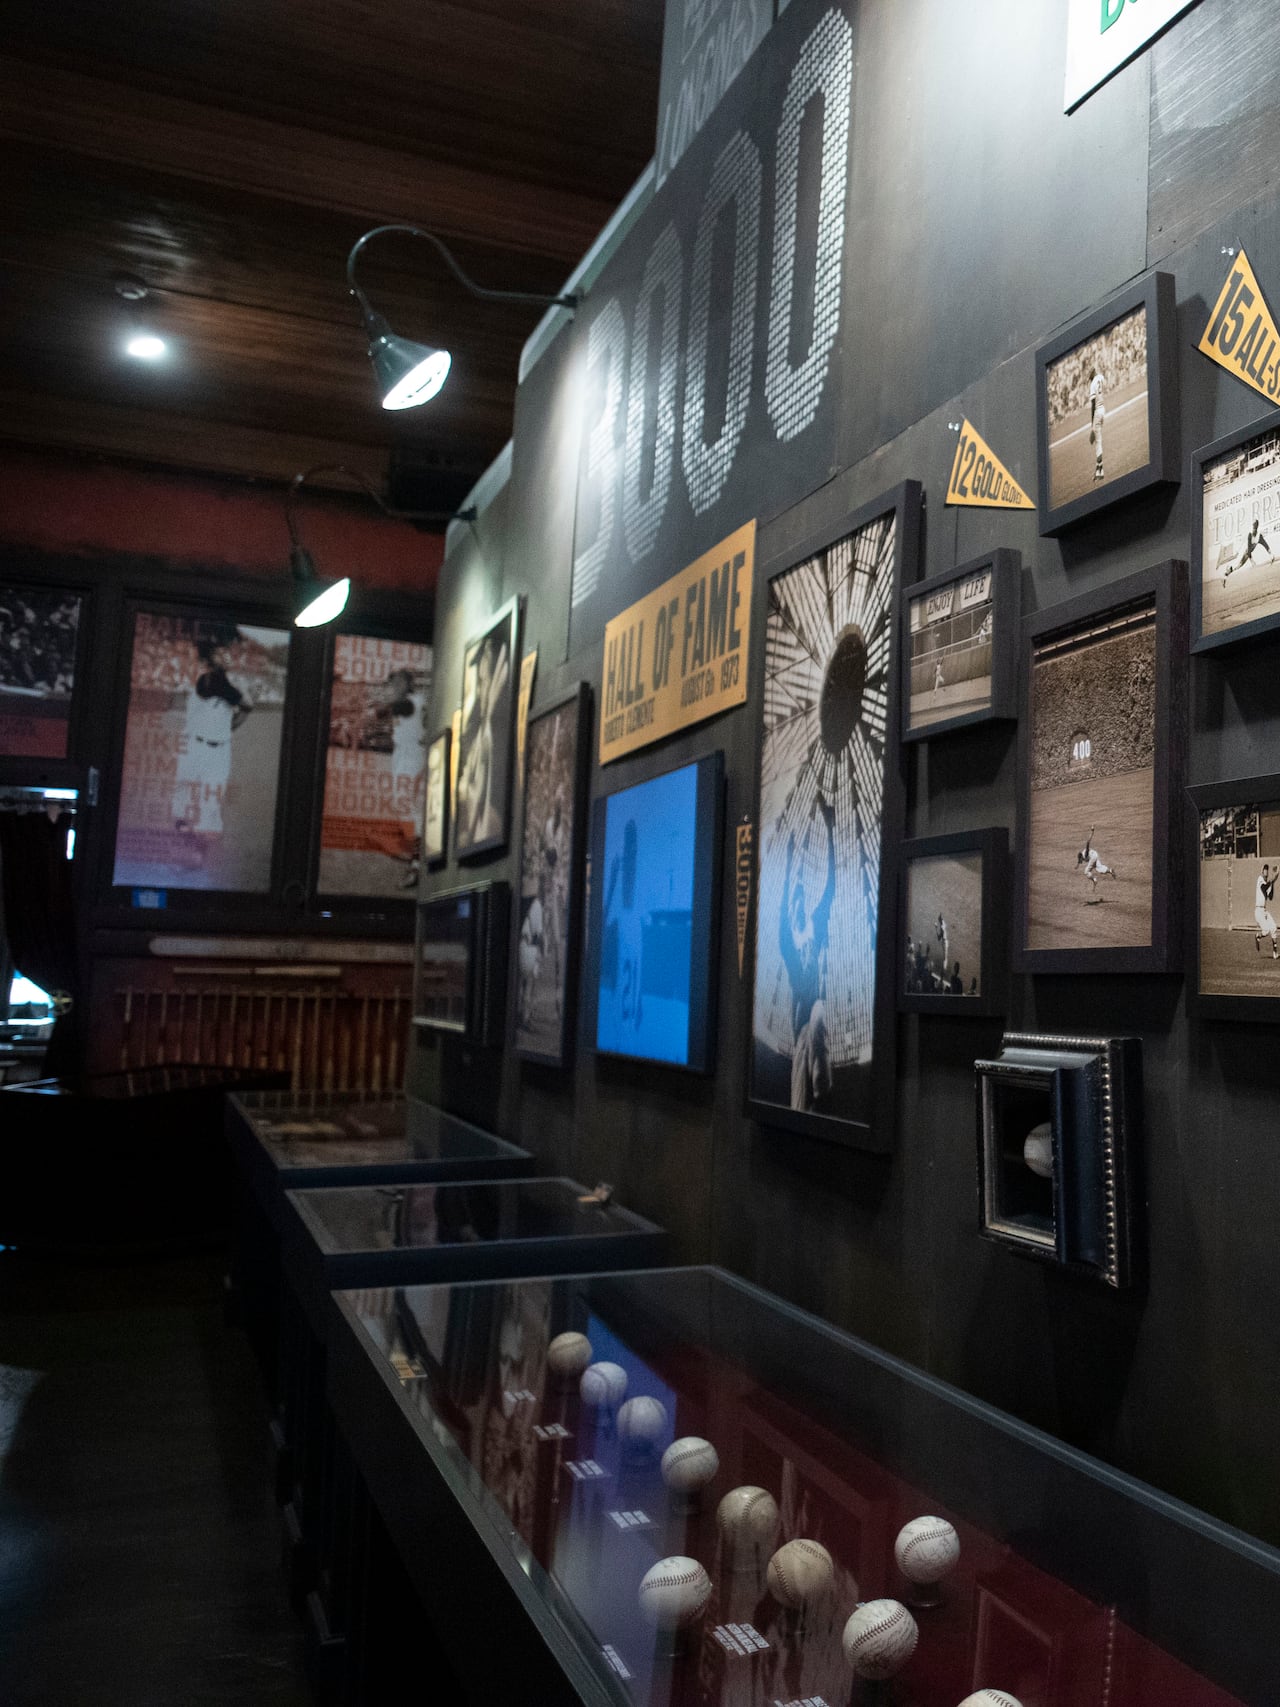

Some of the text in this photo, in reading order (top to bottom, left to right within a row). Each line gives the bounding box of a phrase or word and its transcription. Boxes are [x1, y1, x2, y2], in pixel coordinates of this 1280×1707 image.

[572, 8, 852, 608] 3000
[1207, 270, 1255, 356] 15
[951, 435, 977, 498] 12
[971, 454, 1003, 500] GOLD
[928, 576, 987, 616] ENJOY LIFE
[605, 619, 645, 718] HALL
[652, 596, 679, 693] OF
[680, 550, 746, 678] FAME
[720, 653, 740, 693] 1973
[1073, 739, 1090, 760] 400
